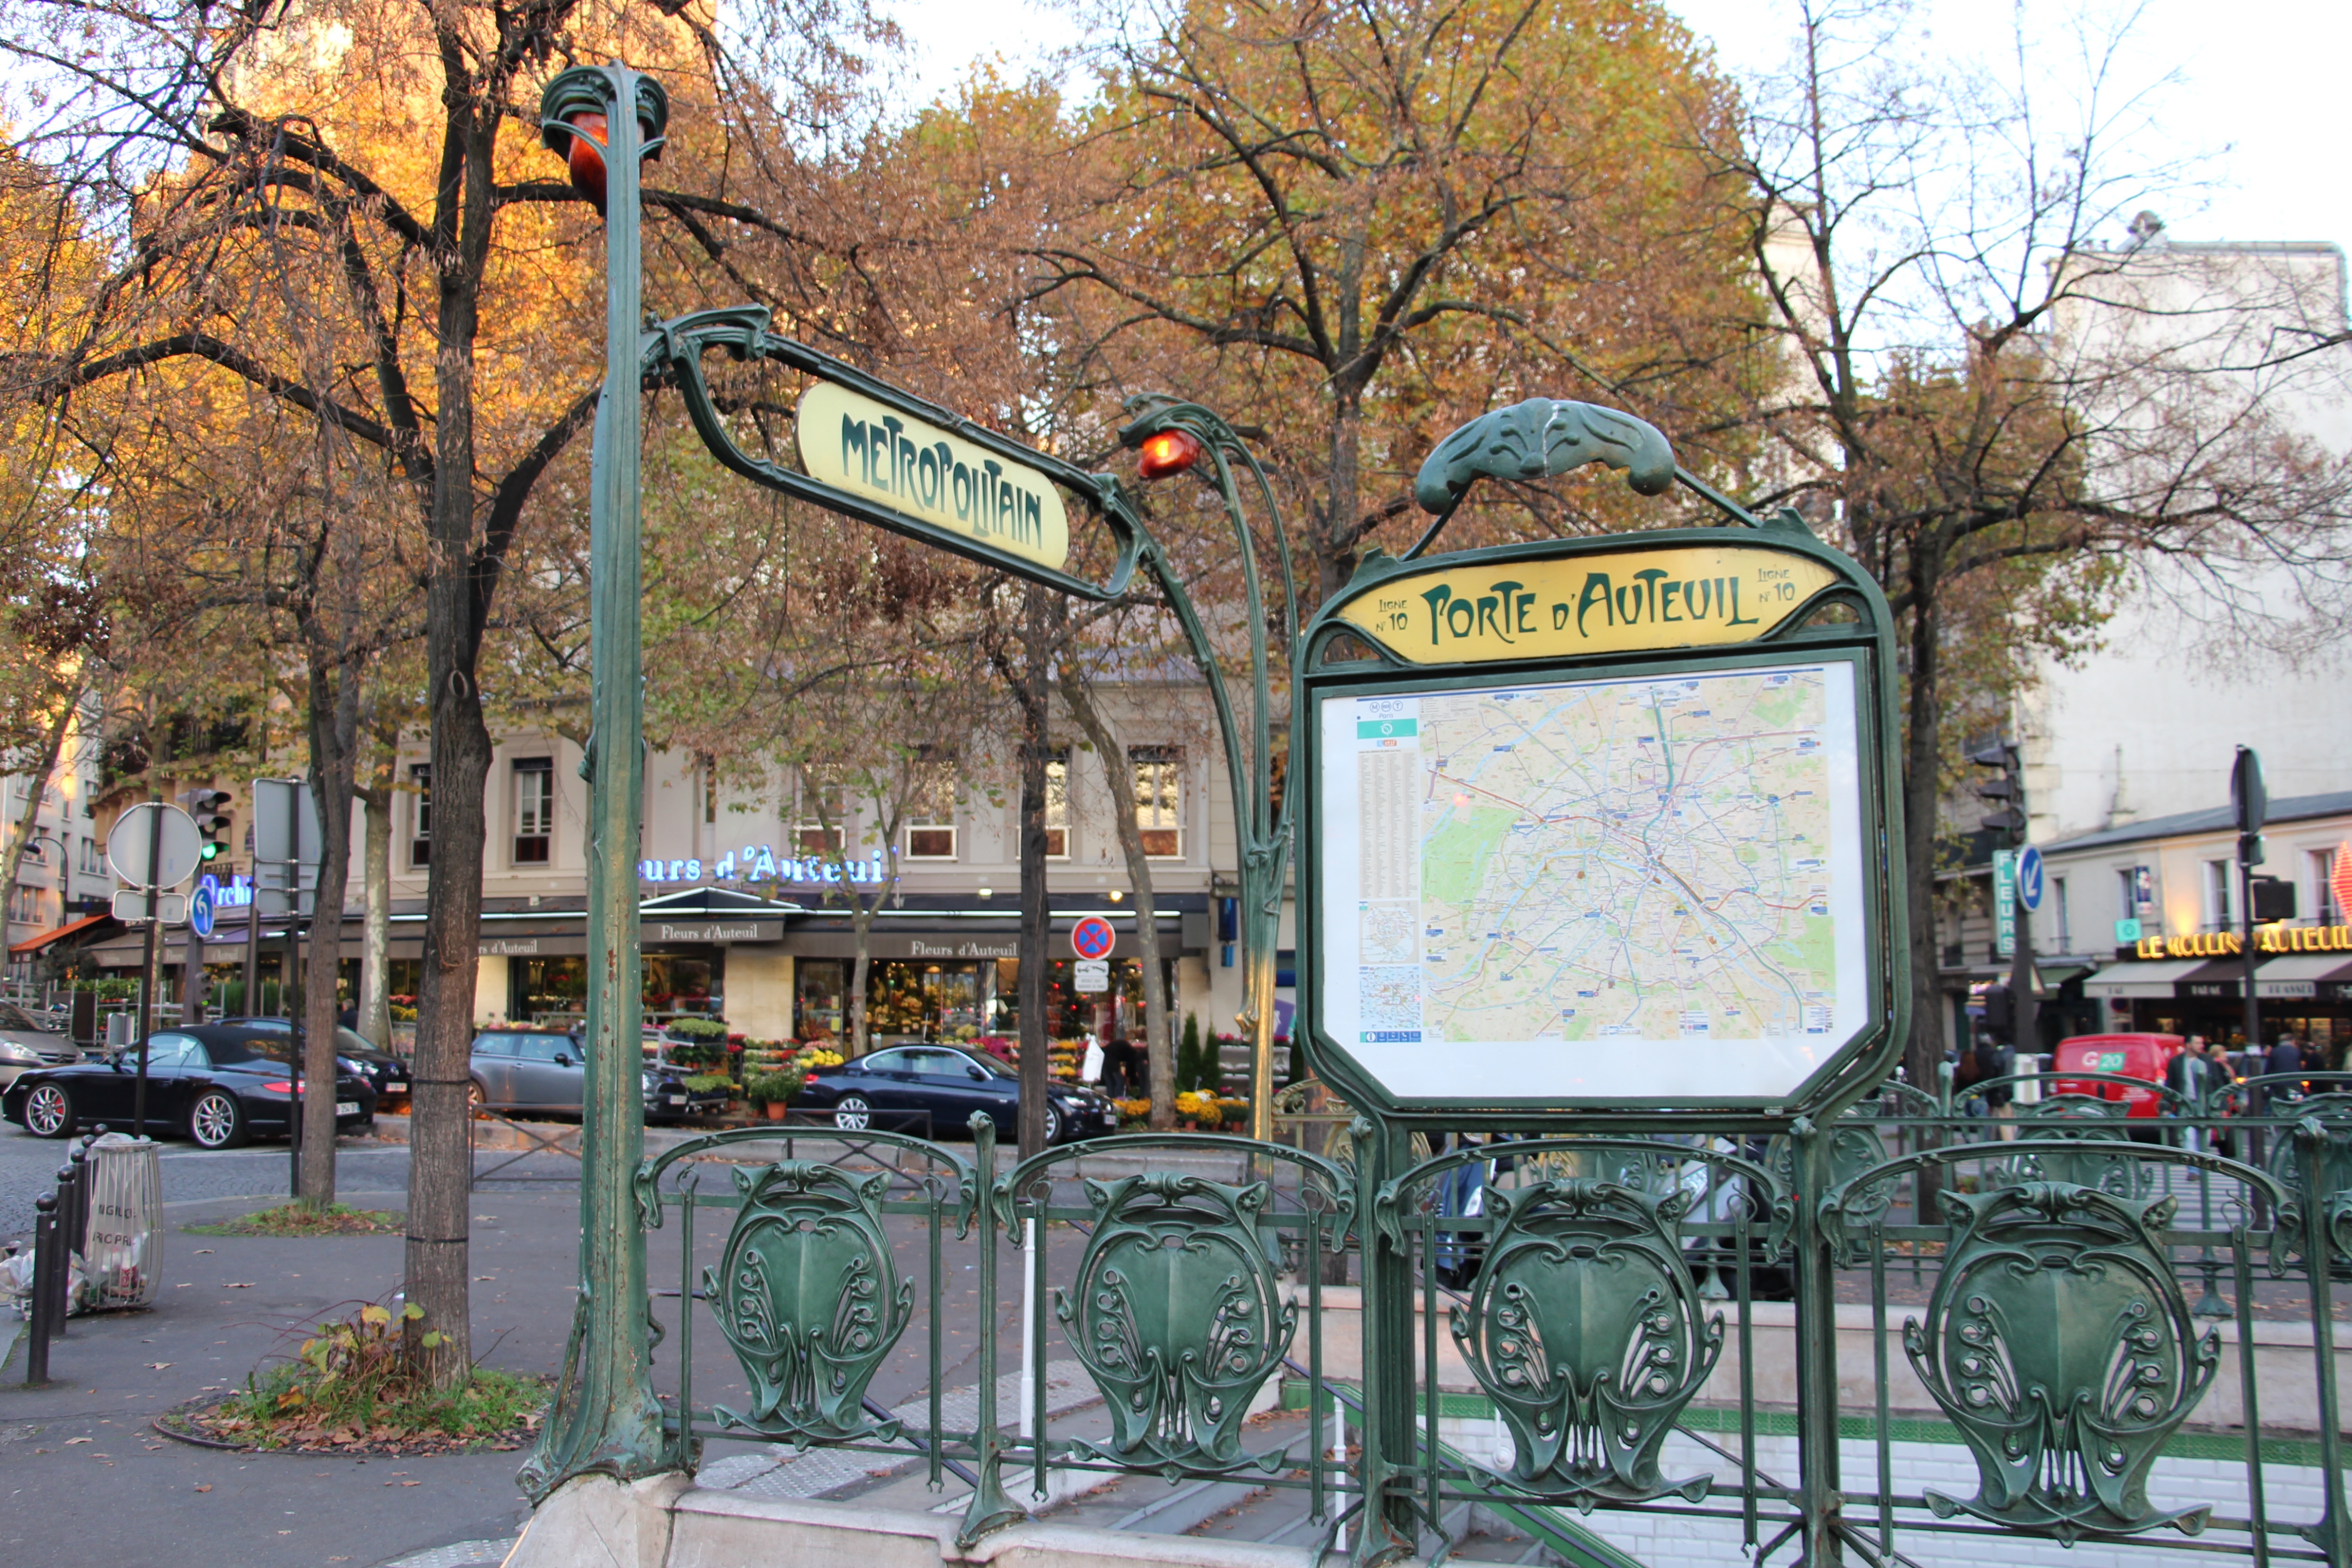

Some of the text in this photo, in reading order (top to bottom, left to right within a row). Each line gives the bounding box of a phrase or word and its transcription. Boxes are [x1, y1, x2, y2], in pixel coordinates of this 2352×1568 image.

[842, 412, 1043, 550] METROPOLITAIN
[1757, 568, 1790, 583] LIGNE
[1774, 582, 1796, 601] 10
[1378, 599, 1407, 612] LIGNE
[1420, 580, 1538, 645] PORTE
[1389, 612, 1408, 631] 10
[637, 858, 701, 881] urs
[1999, 853, 2016, 951] FLEURS
[662, 923, 758, 939] Fleurs d'Auteuil
[491, 938, 538, 954] d'Auteuil
[911, 940, 1017, 956] Fleurs d'Auteuil
[2137, 935, 2165, 959] LE
